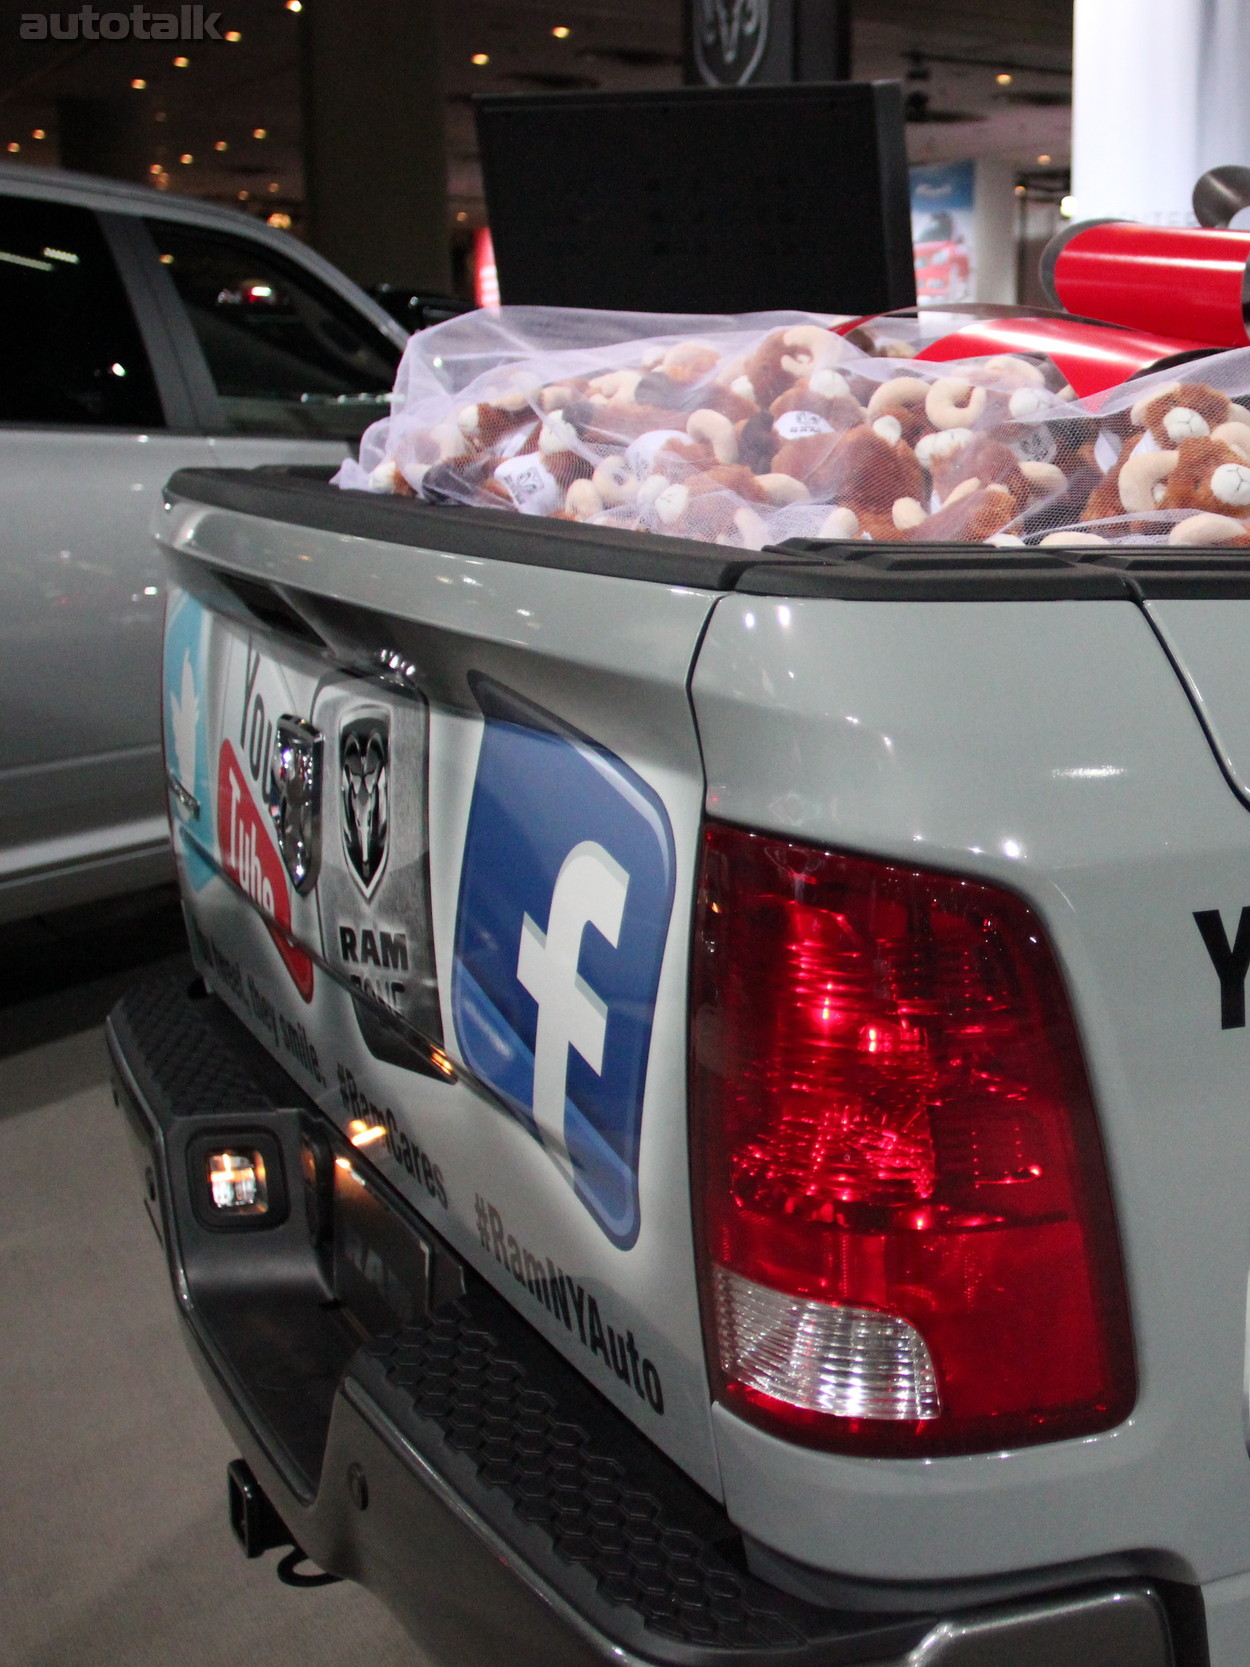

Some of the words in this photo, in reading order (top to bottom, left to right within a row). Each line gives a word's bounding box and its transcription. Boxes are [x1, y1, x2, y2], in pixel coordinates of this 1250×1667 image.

[339, 926, 409, 971] RAM
[337, 1062, 449, 1211] #RamCares
[474, 1193, 665, 1416] #RamNYAuto
